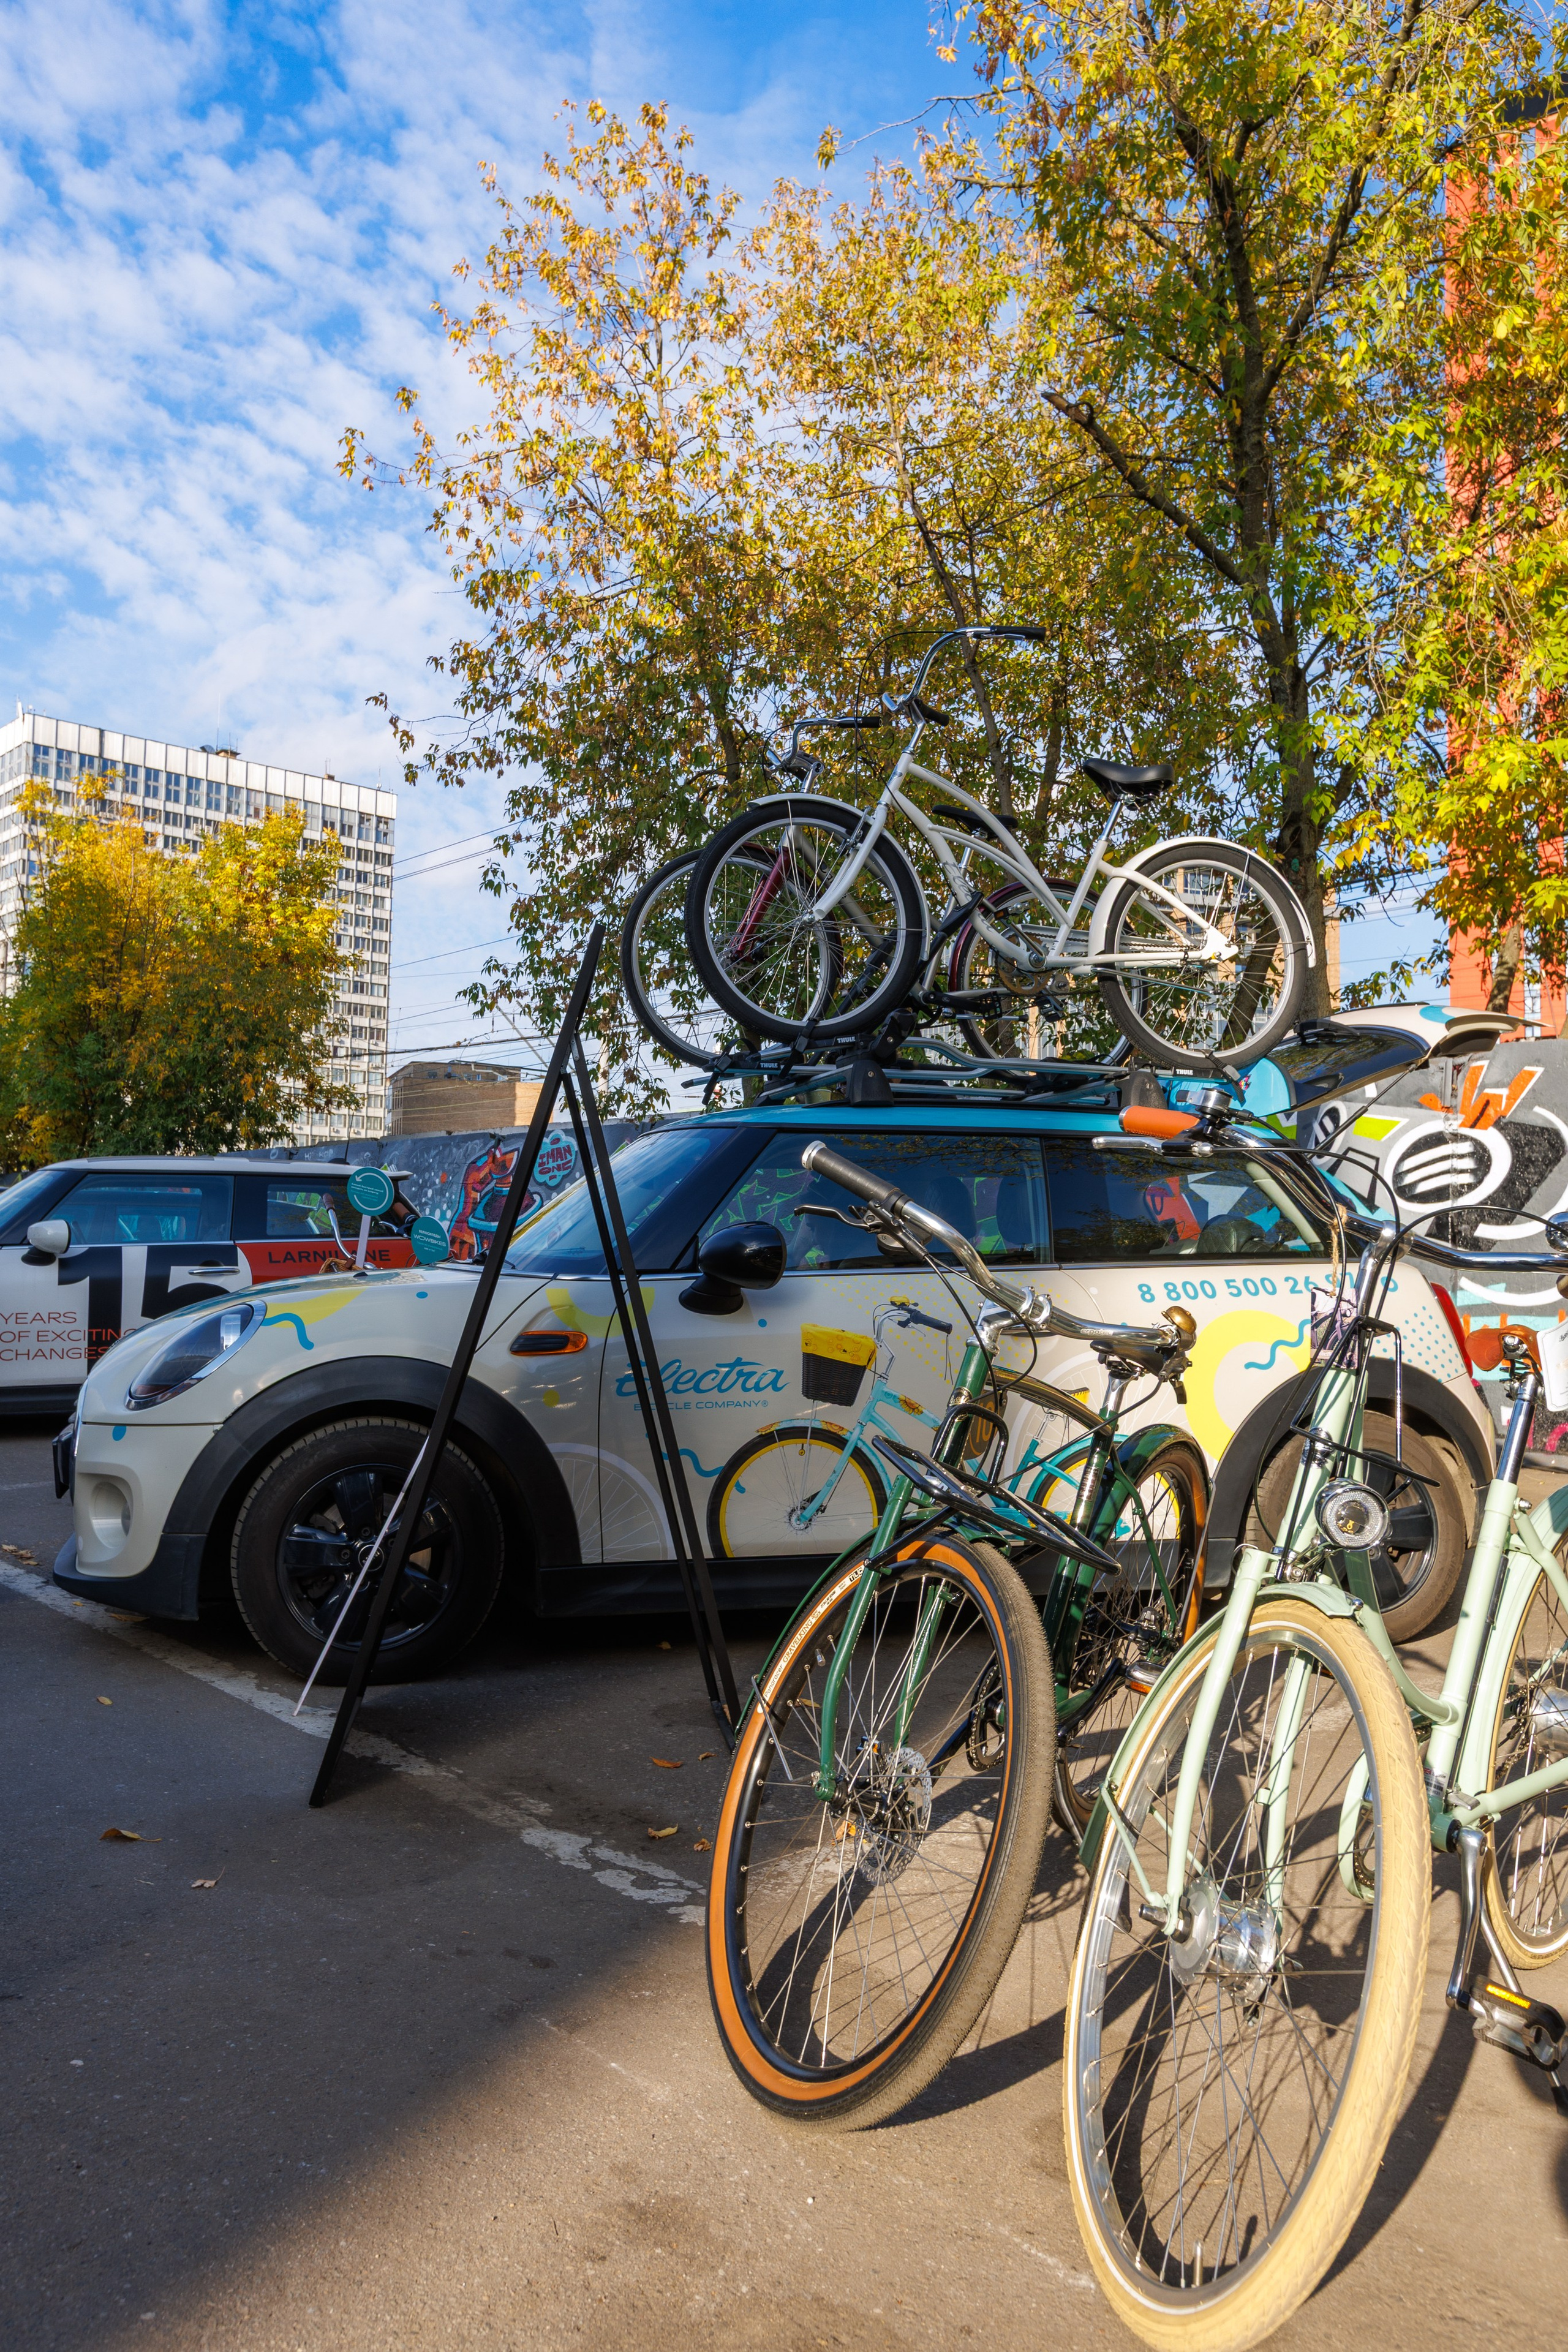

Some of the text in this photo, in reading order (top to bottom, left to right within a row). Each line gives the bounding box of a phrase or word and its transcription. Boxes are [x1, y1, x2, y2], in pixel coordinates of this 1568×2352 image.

[538, 1144, 573, 1167] IMAN
[413, 1234, 447, 1247] WOWBIKES
[1137, 1283, 1156, 1303] 8
[1163, 1280, 1217, 1302] 800
[1224, 1276, 1278, 1297] 500
[1284, 1276, 1319, 1294] 26
[0, 1311, 77, 1325] YEARS
[0, 1329, 137, 1343] OF EXCITIN
[616, 1357, 791, 1397] Electra
[634, 1401, 692, 1411] BCCLE
[764, 1619, 813, 1698] Panaracer GRAVELKING
